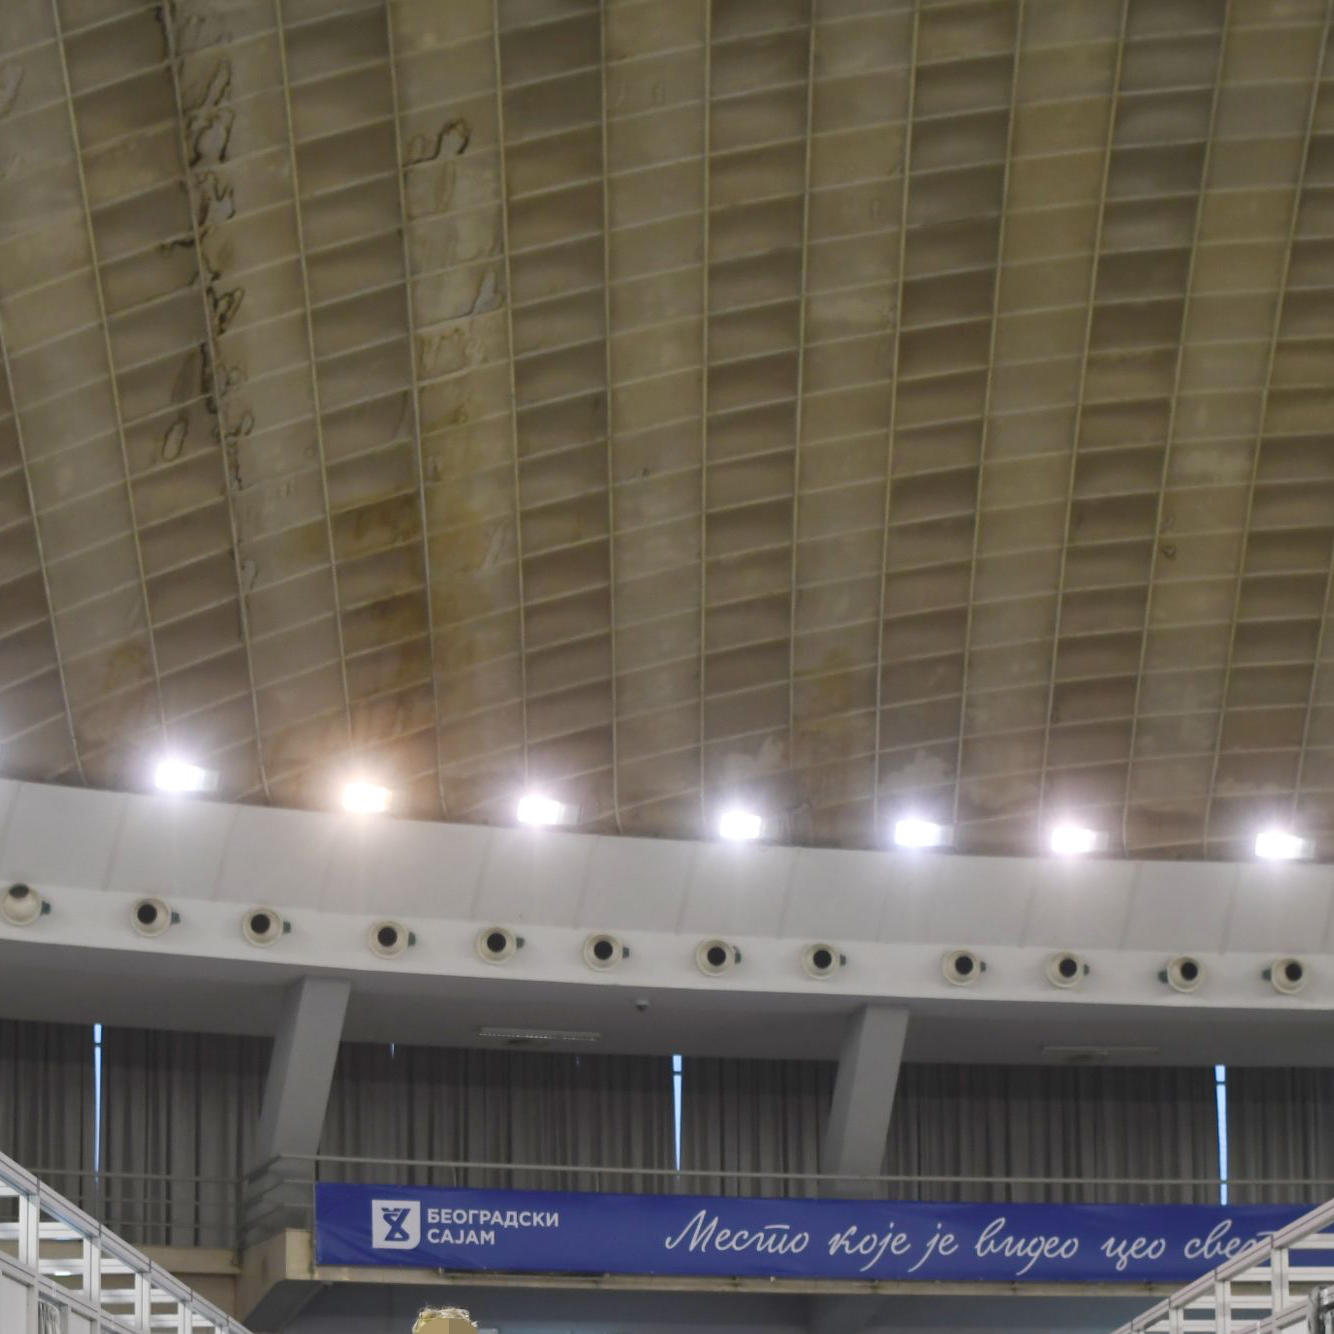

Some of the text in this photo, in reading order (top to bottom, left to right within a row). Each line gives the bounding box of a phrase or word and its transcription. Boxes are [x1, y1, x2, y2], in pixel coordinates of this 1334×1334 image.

[427, 1208, 559, 1228] БЕОГРАДСКИ
[427, 1228, 495, 1245] САЈАМ
[665, 1209, 809, 1254] Место
[828, 1221, 911, 1272] које
[907, 1222, 958, 1273] је
[974, 1217, 1079, 1276] видео
[1100, 1236, 1166, 1271] цео
